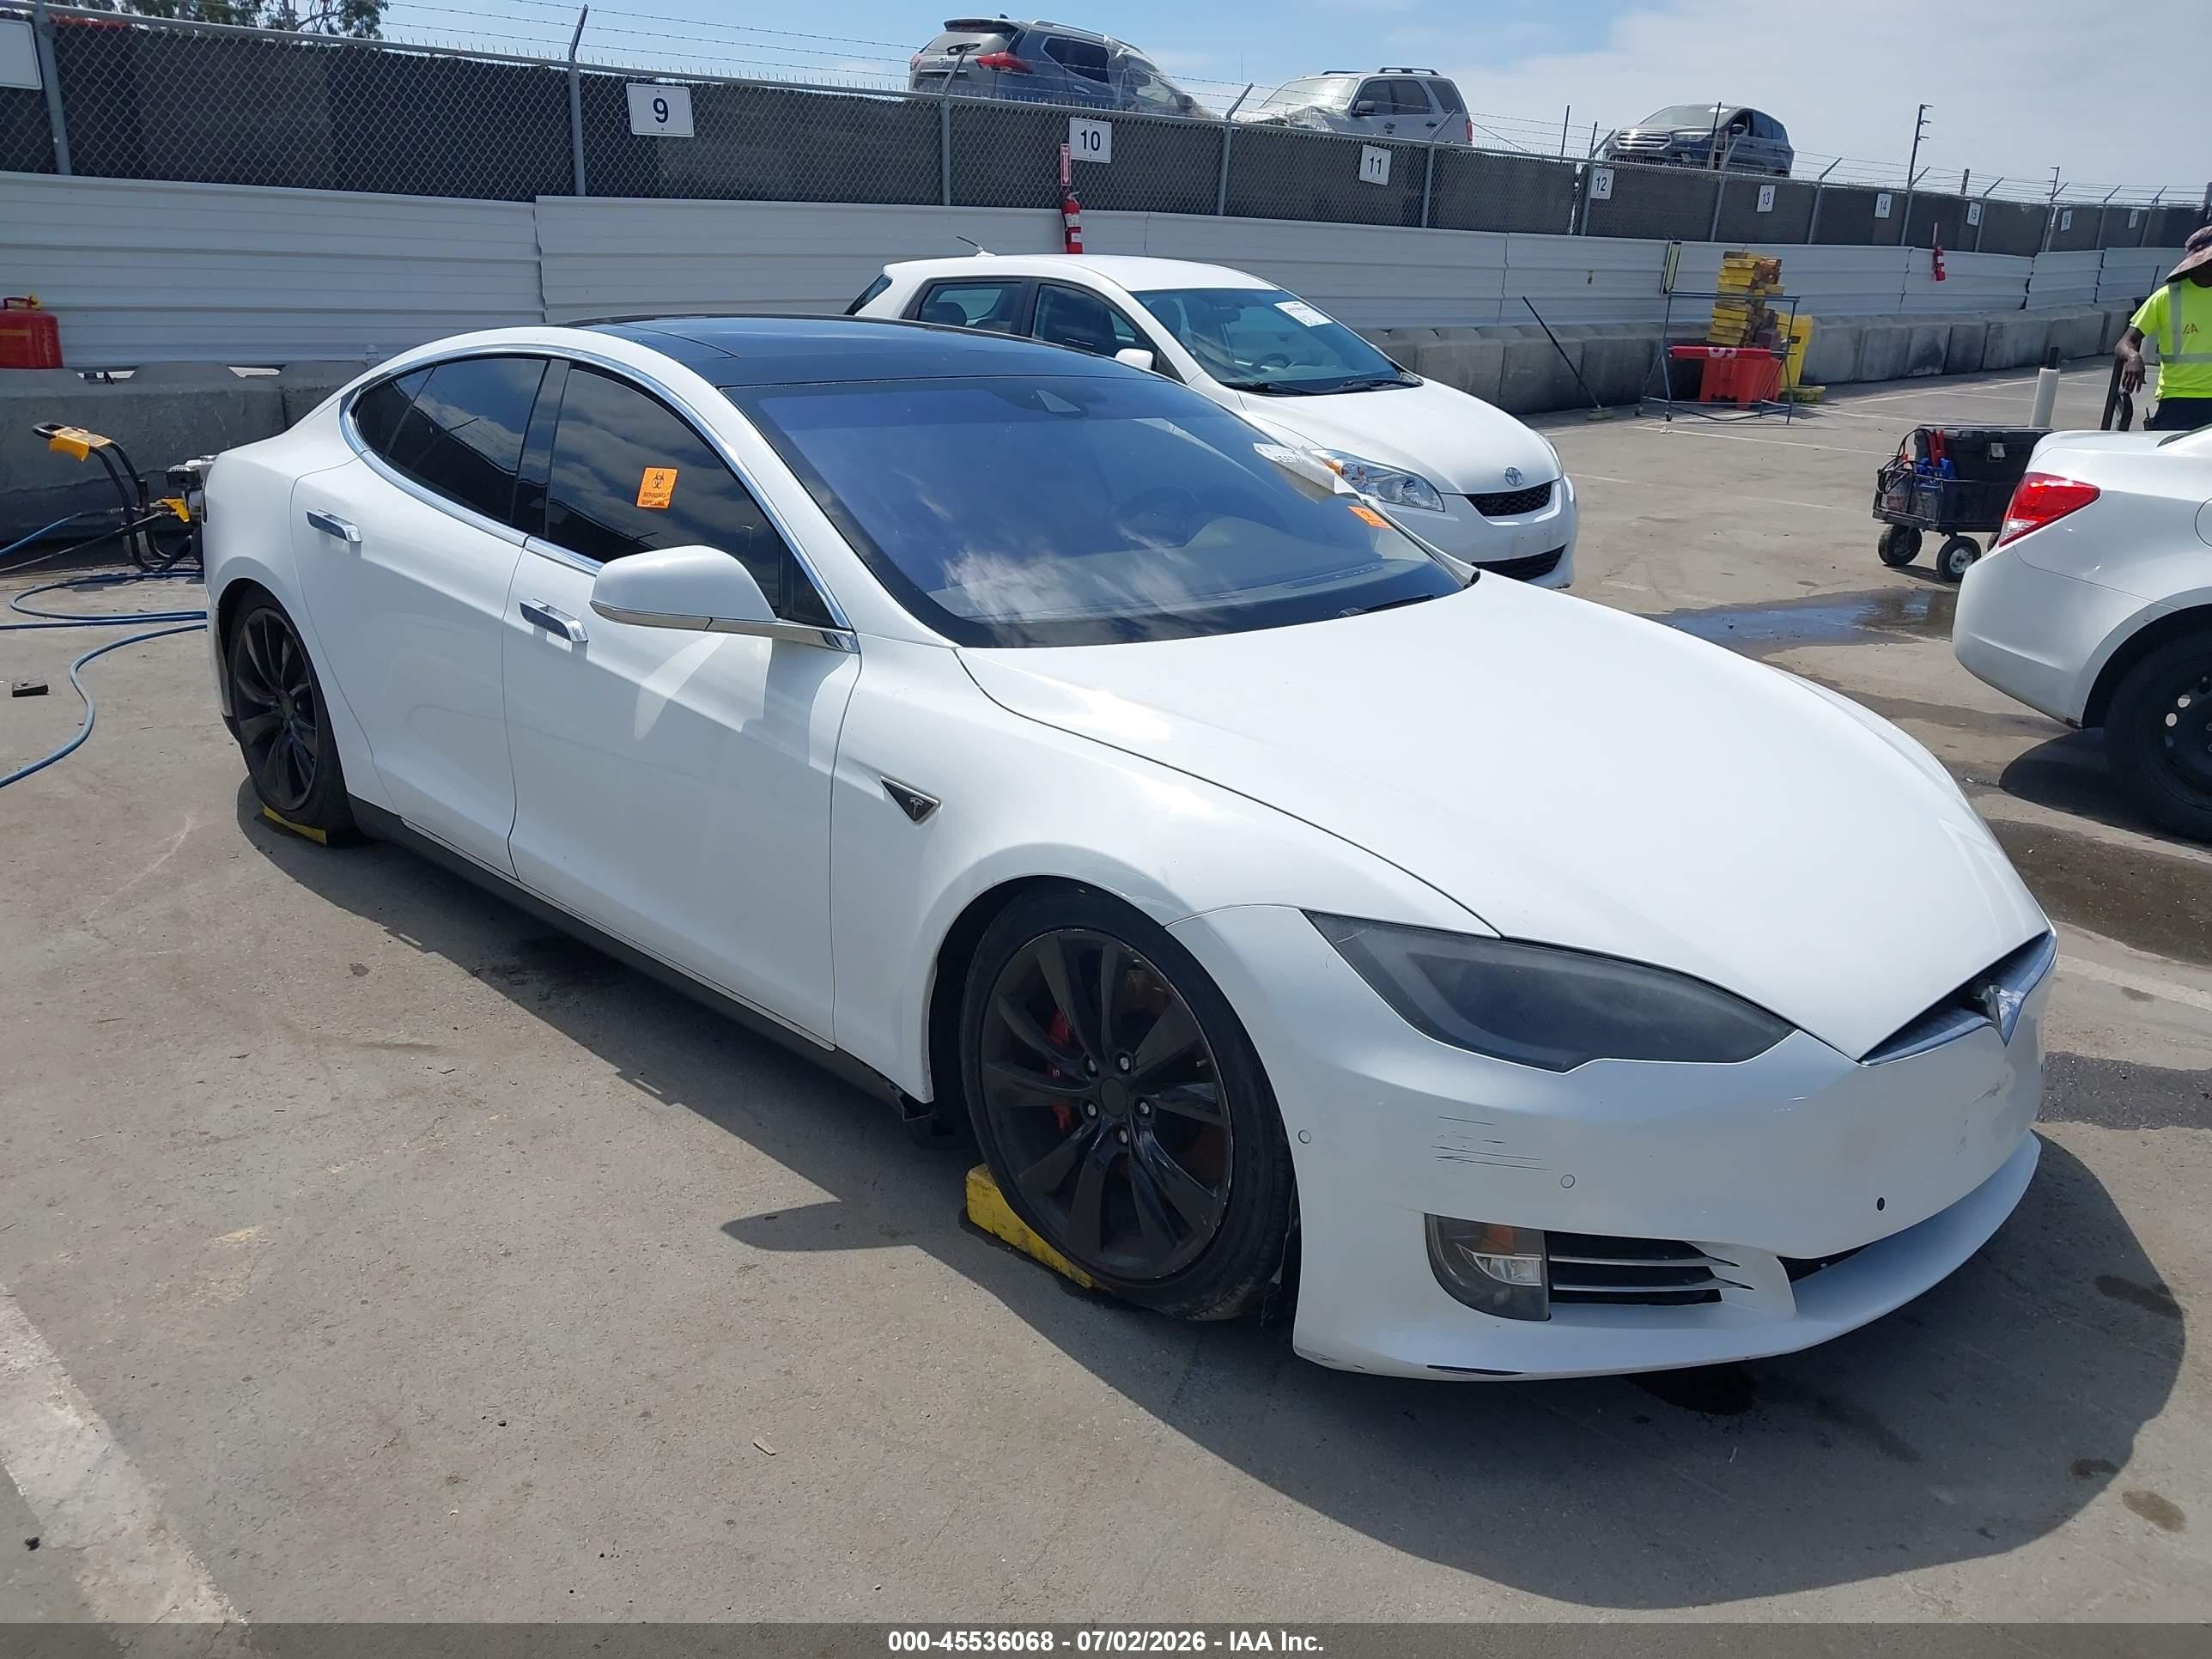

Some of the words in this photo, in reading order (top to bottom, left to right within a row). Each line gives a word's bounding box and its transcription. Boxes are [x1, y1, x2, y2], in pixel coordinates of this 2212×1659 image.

[653, 98, 669, 124] 9
[1080, 129, 1101, 152] 10
[1369, 155, 1382, 175] 11
[1595, 175, 1607, 191] 12
[1762, 191, 1771, 206] 13
[1880, 199, 1888, 212] 14
